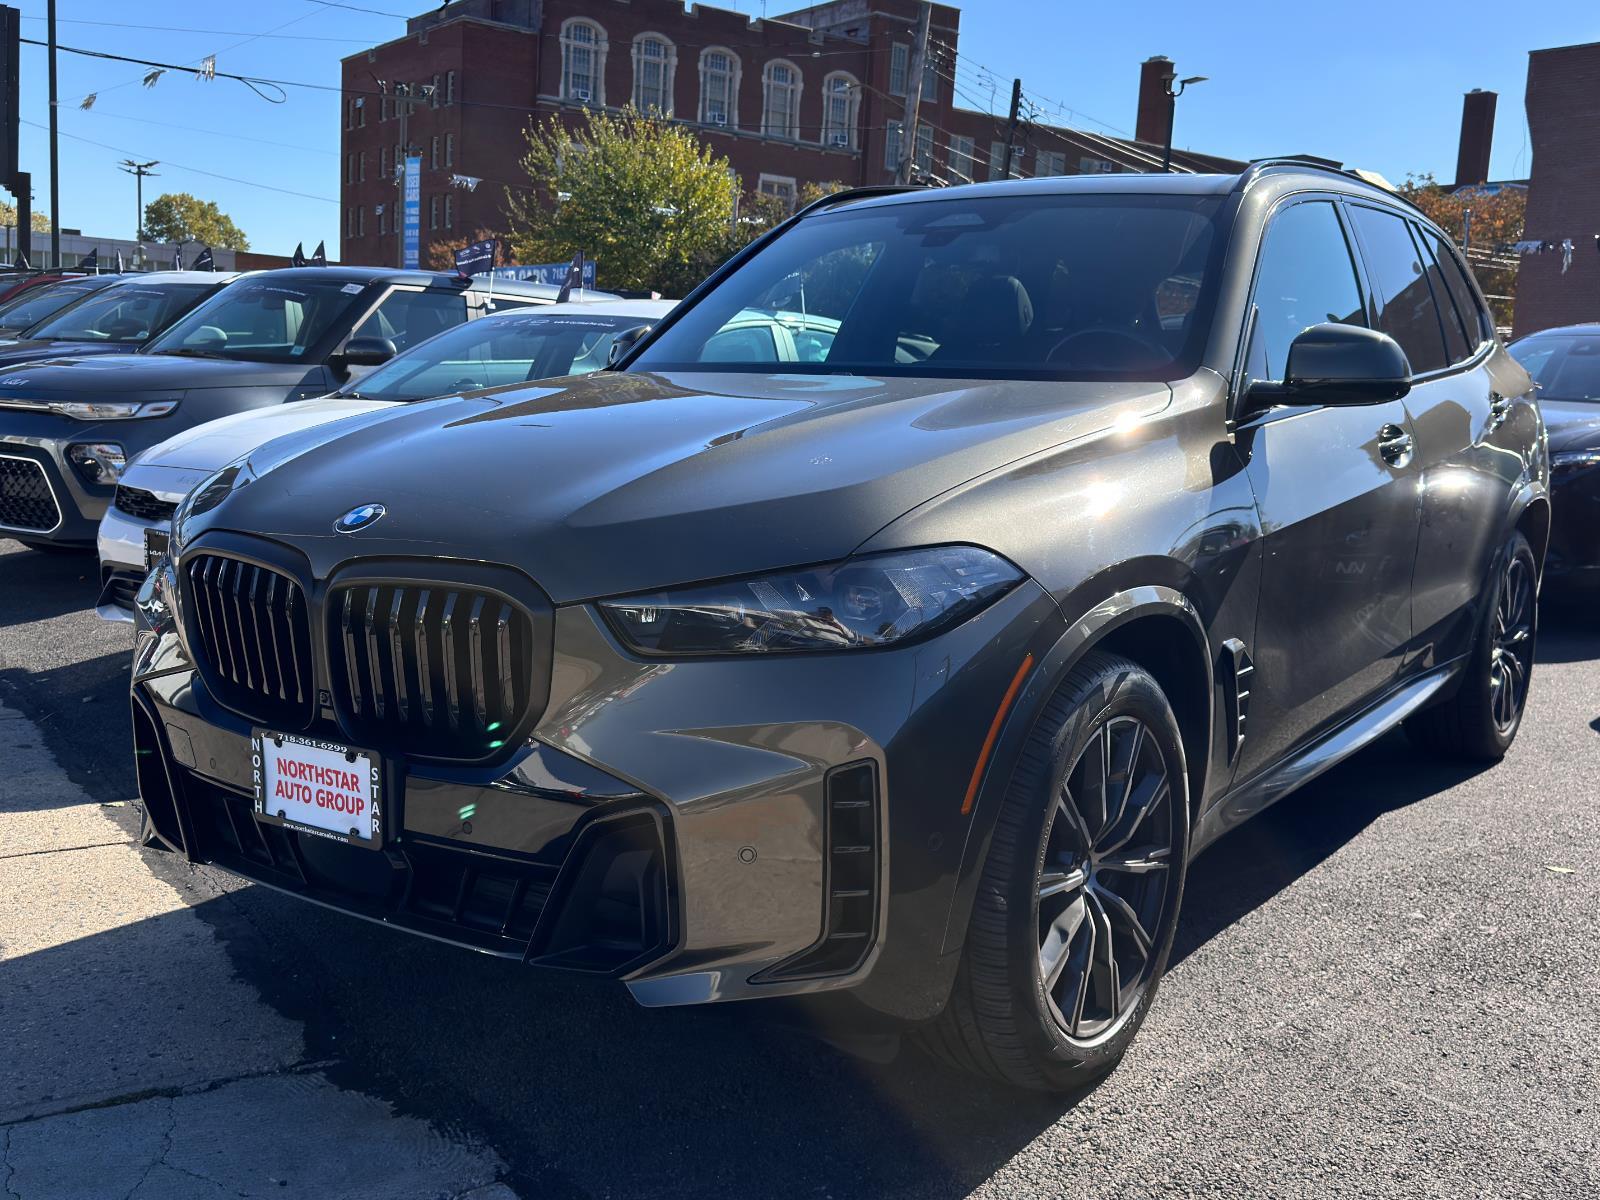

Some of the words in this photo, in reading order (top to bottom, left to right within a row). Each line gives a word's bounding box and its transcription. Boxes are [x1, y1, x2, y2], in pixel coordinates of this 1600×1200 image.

[277, 733, 348, 753] 718-361-6299
[251, 738, 263, 814] NORTH
[276, 757, 361, 793] NORTHSTAR
[275, 779, 312, 804] AUTO
[315, 788, 365, 816] GROUP
[370, 767, 381, 833] STAR
